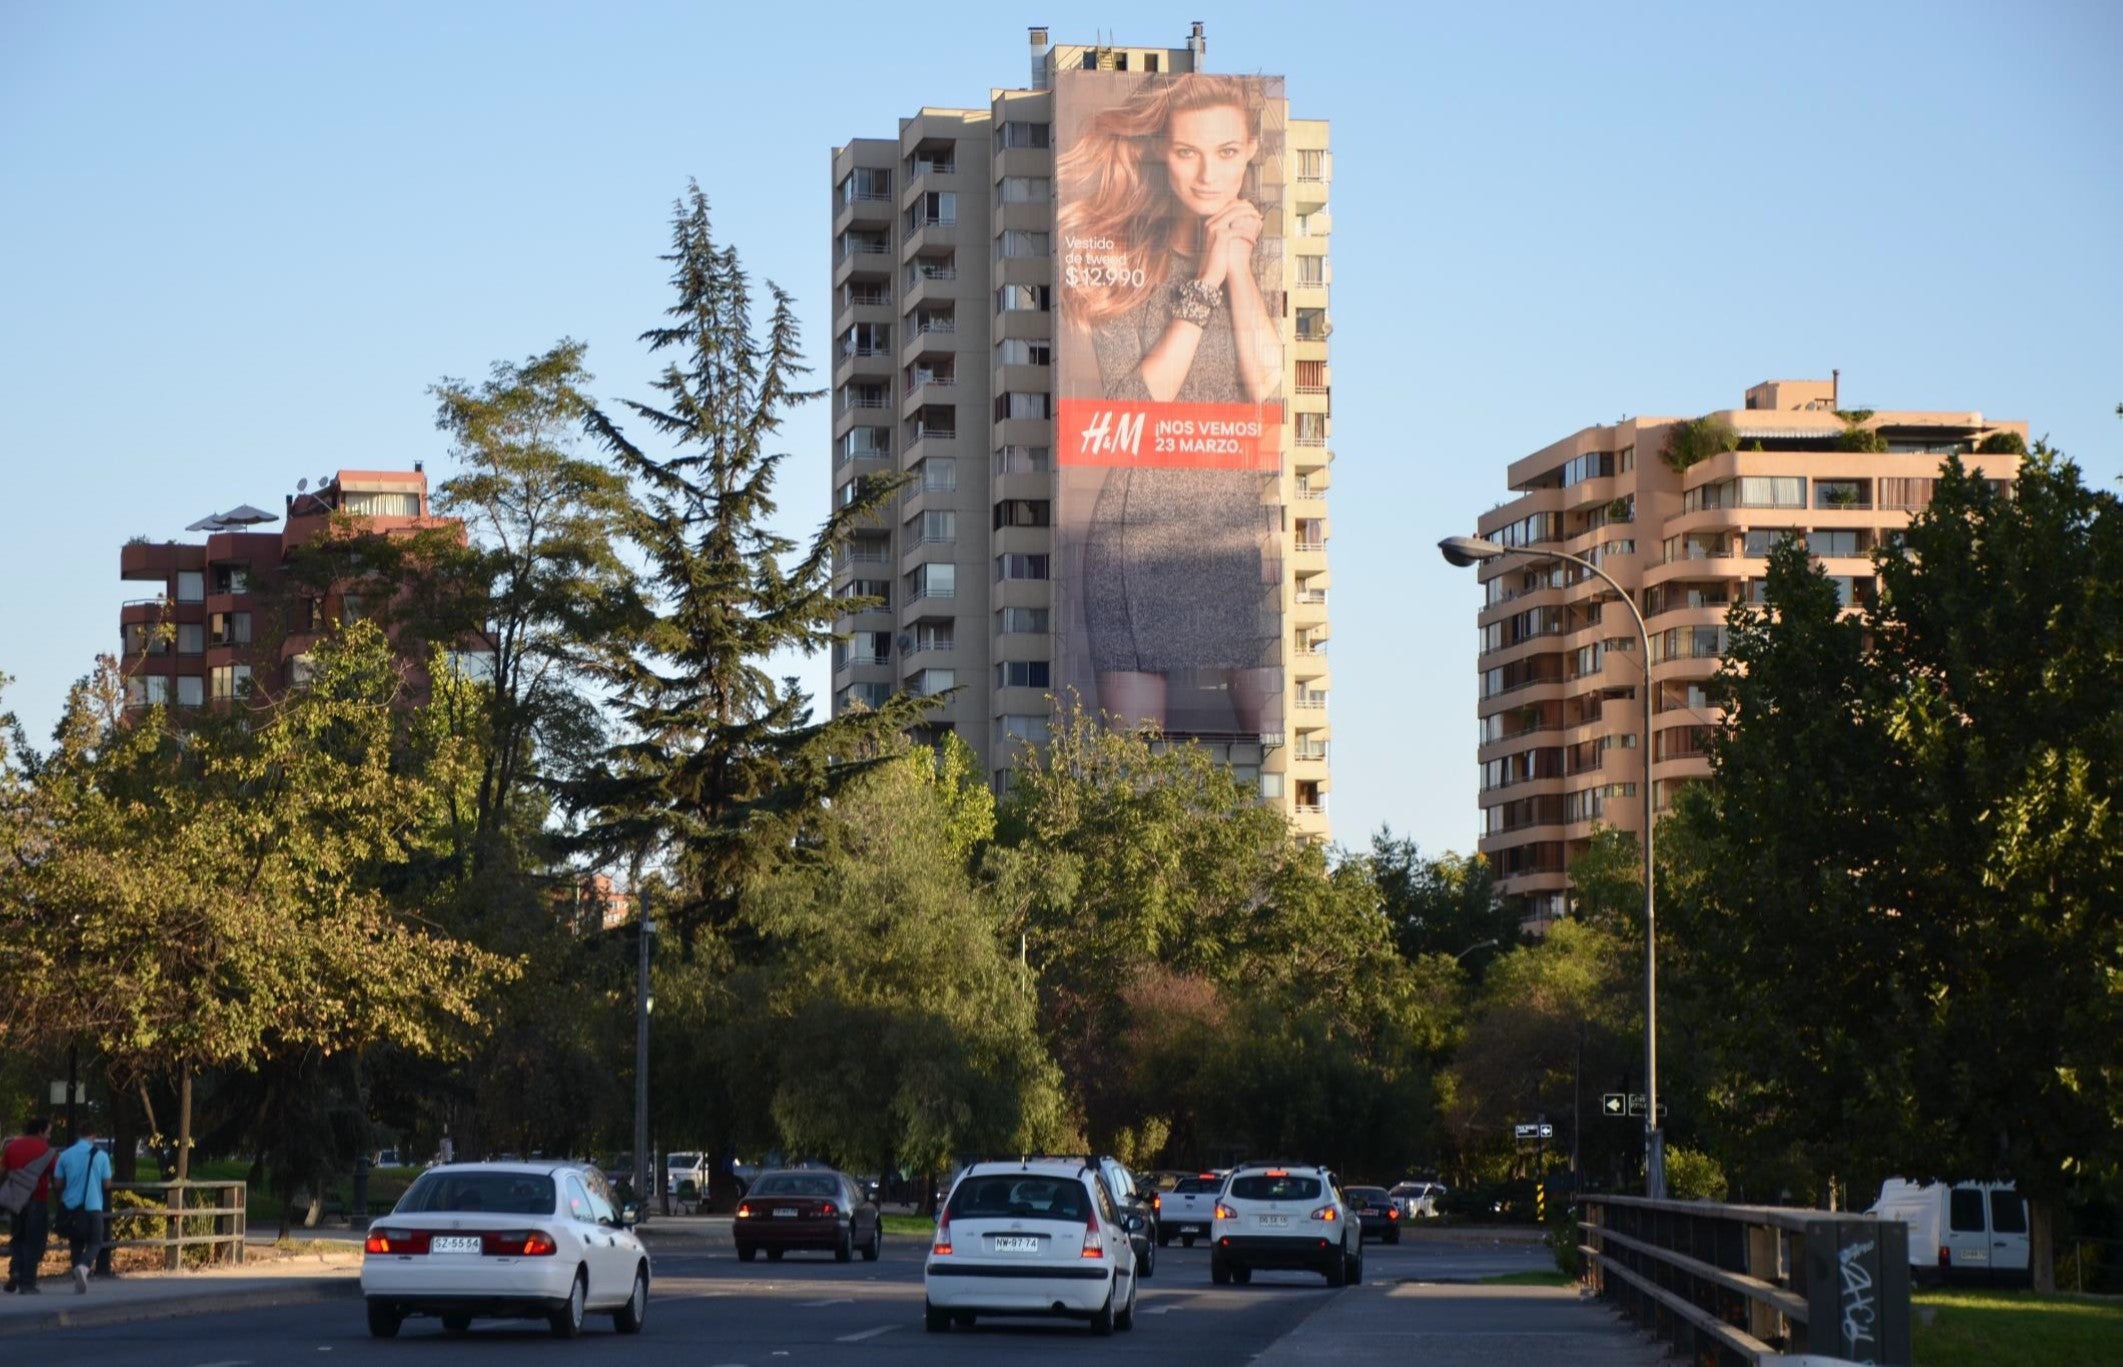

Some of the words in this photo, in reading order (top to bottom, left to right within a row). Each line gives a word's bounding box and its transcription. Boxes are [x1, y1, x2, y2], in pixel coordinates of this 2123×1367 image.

[1065, 235, 1114, 250] Vestido
[1065, 252, 1082, 265] de
[1086, 252, 1127, 265] tweed
[1080, 410, 1146, 457] H&M
[1155, 420, 1194, 437] ¡NOS
[1197, 421, 1262, 437] VEMOS!
[1155, 438, 1176, 452] 23
[1179, 438, 1243, 454] MARZO.
